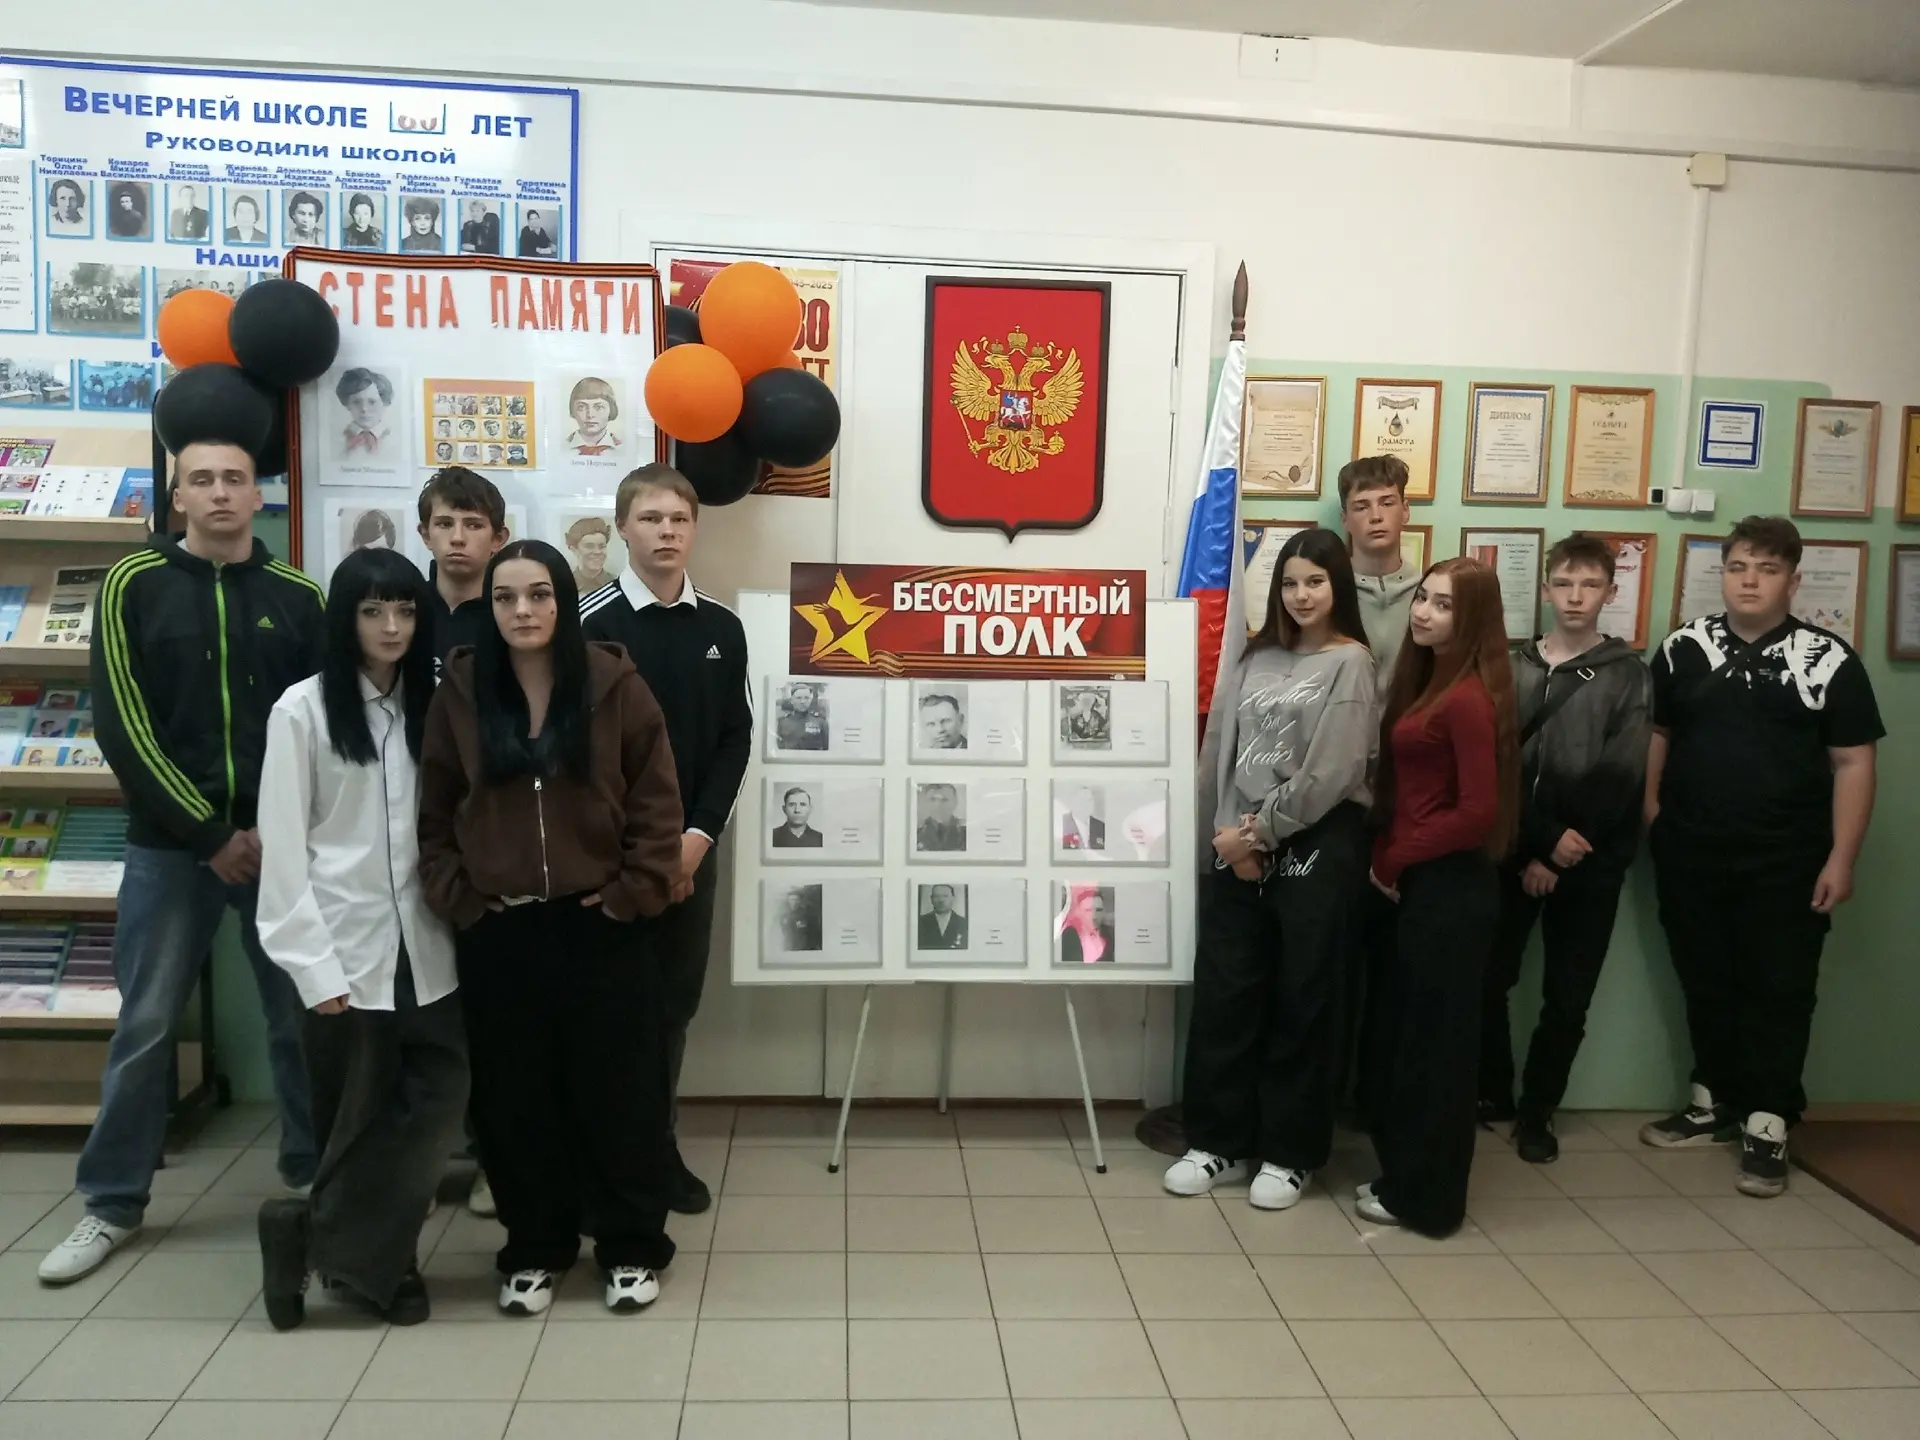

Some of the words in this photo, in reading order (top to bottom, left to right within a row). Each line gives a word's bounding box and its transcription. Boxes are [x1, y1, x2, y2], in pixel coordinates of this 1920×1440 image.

[471, 114, 533, 138] ЛЕТ
[54, 162, 83, 170] Ольга
[108, 158, 149, 167] Комаров
[39, 167, 98, 177] Николаевна
[110, 165, 148, 173] Михаил
[228, 171, 278, 179] Маргарита
[284, 173, 326, 181] Надежда
[280, 180, 331, 188] Борисовна
[335, 175, 391, 185] Александра
[341, 182, 387, 191] Павловна
[400, 185, 446, 194] Ивановна
[464, 182, 499, 191] Тамара
[521, 186, 557, 195] Любовь
[516, 192, 561, 202] Ивановна
[319, 271, 459, 329] СТЕНА
[490, 275, 641, 334] ПАМЯТИ
[1489, 411, 1532, 421] ДИПЛОМ
[1377, 436, 1415, 446] Грамота
[893, 578, 1131, 615] БЕССМЕРТНЫЙ
[943, 615, 1088, 657] ПОЛК
